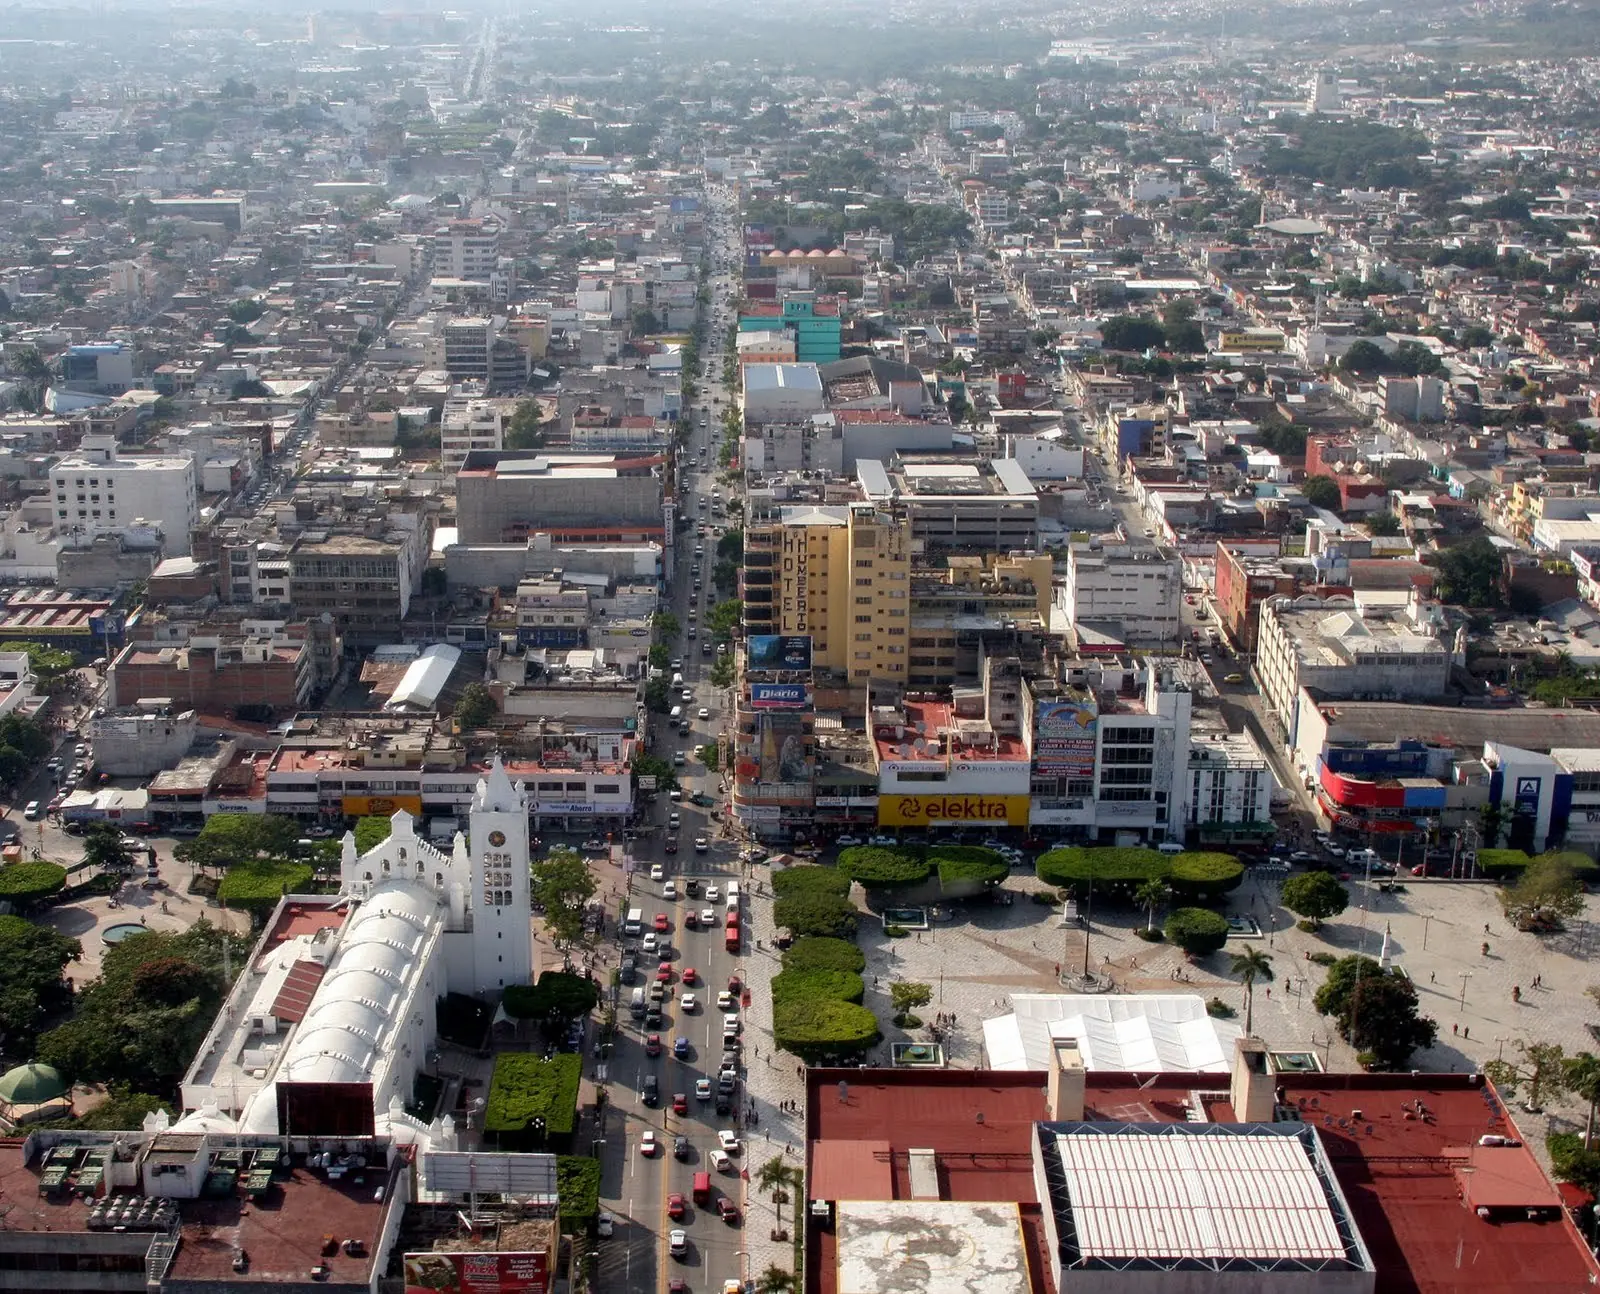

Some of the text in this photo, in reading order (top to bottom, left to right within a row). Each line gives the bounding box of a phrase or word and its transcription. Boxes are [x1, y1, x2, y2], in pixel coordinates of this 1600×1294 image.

[783, 531, 794, 631] HOTEL
[796, 531, 808, 632] HUMBERTO
[759, 689, 799, 699] Diario
[569, 804, 593, 812] Ahorro
[925, 798, 1008, 819] elektra
